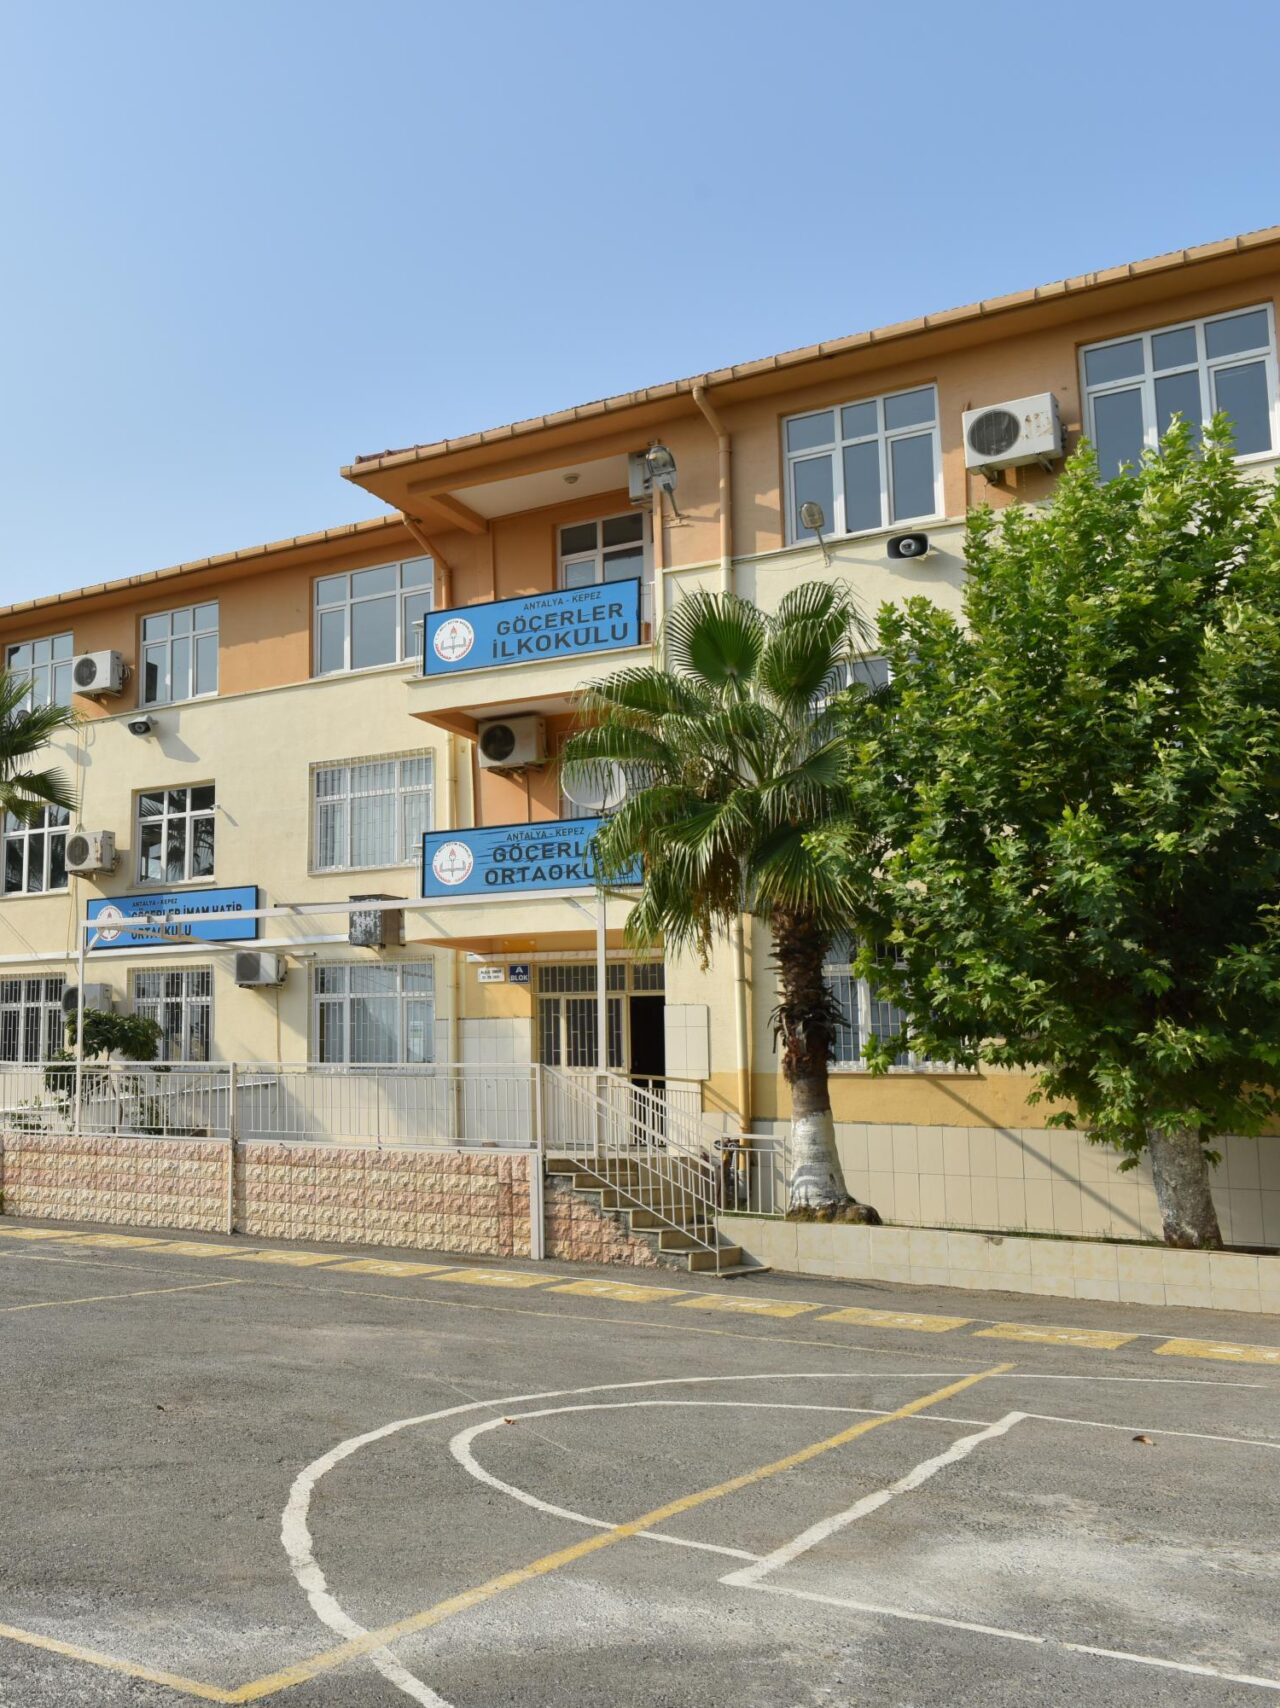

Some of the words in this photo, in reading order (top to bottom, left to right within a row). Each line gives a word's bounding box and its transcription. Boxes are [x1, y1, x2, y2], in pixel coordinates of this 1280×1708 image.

[523, 597, 564, 611] ANTALYA
[572, 591, 602, 603] KEPEZ
[497, 603, 623, 635] GÖÇERLER
[492, 622, 628, 659] İLKOKULU
[506, 830, 547, 842] ANTALYA
[555, 827, 585, 837] KEPEZ
[493, 840, 601, 863] GÖÇERLE
[485, 859, 633, 885] ORTAOKUU
[515, 966, 524, 974] A
